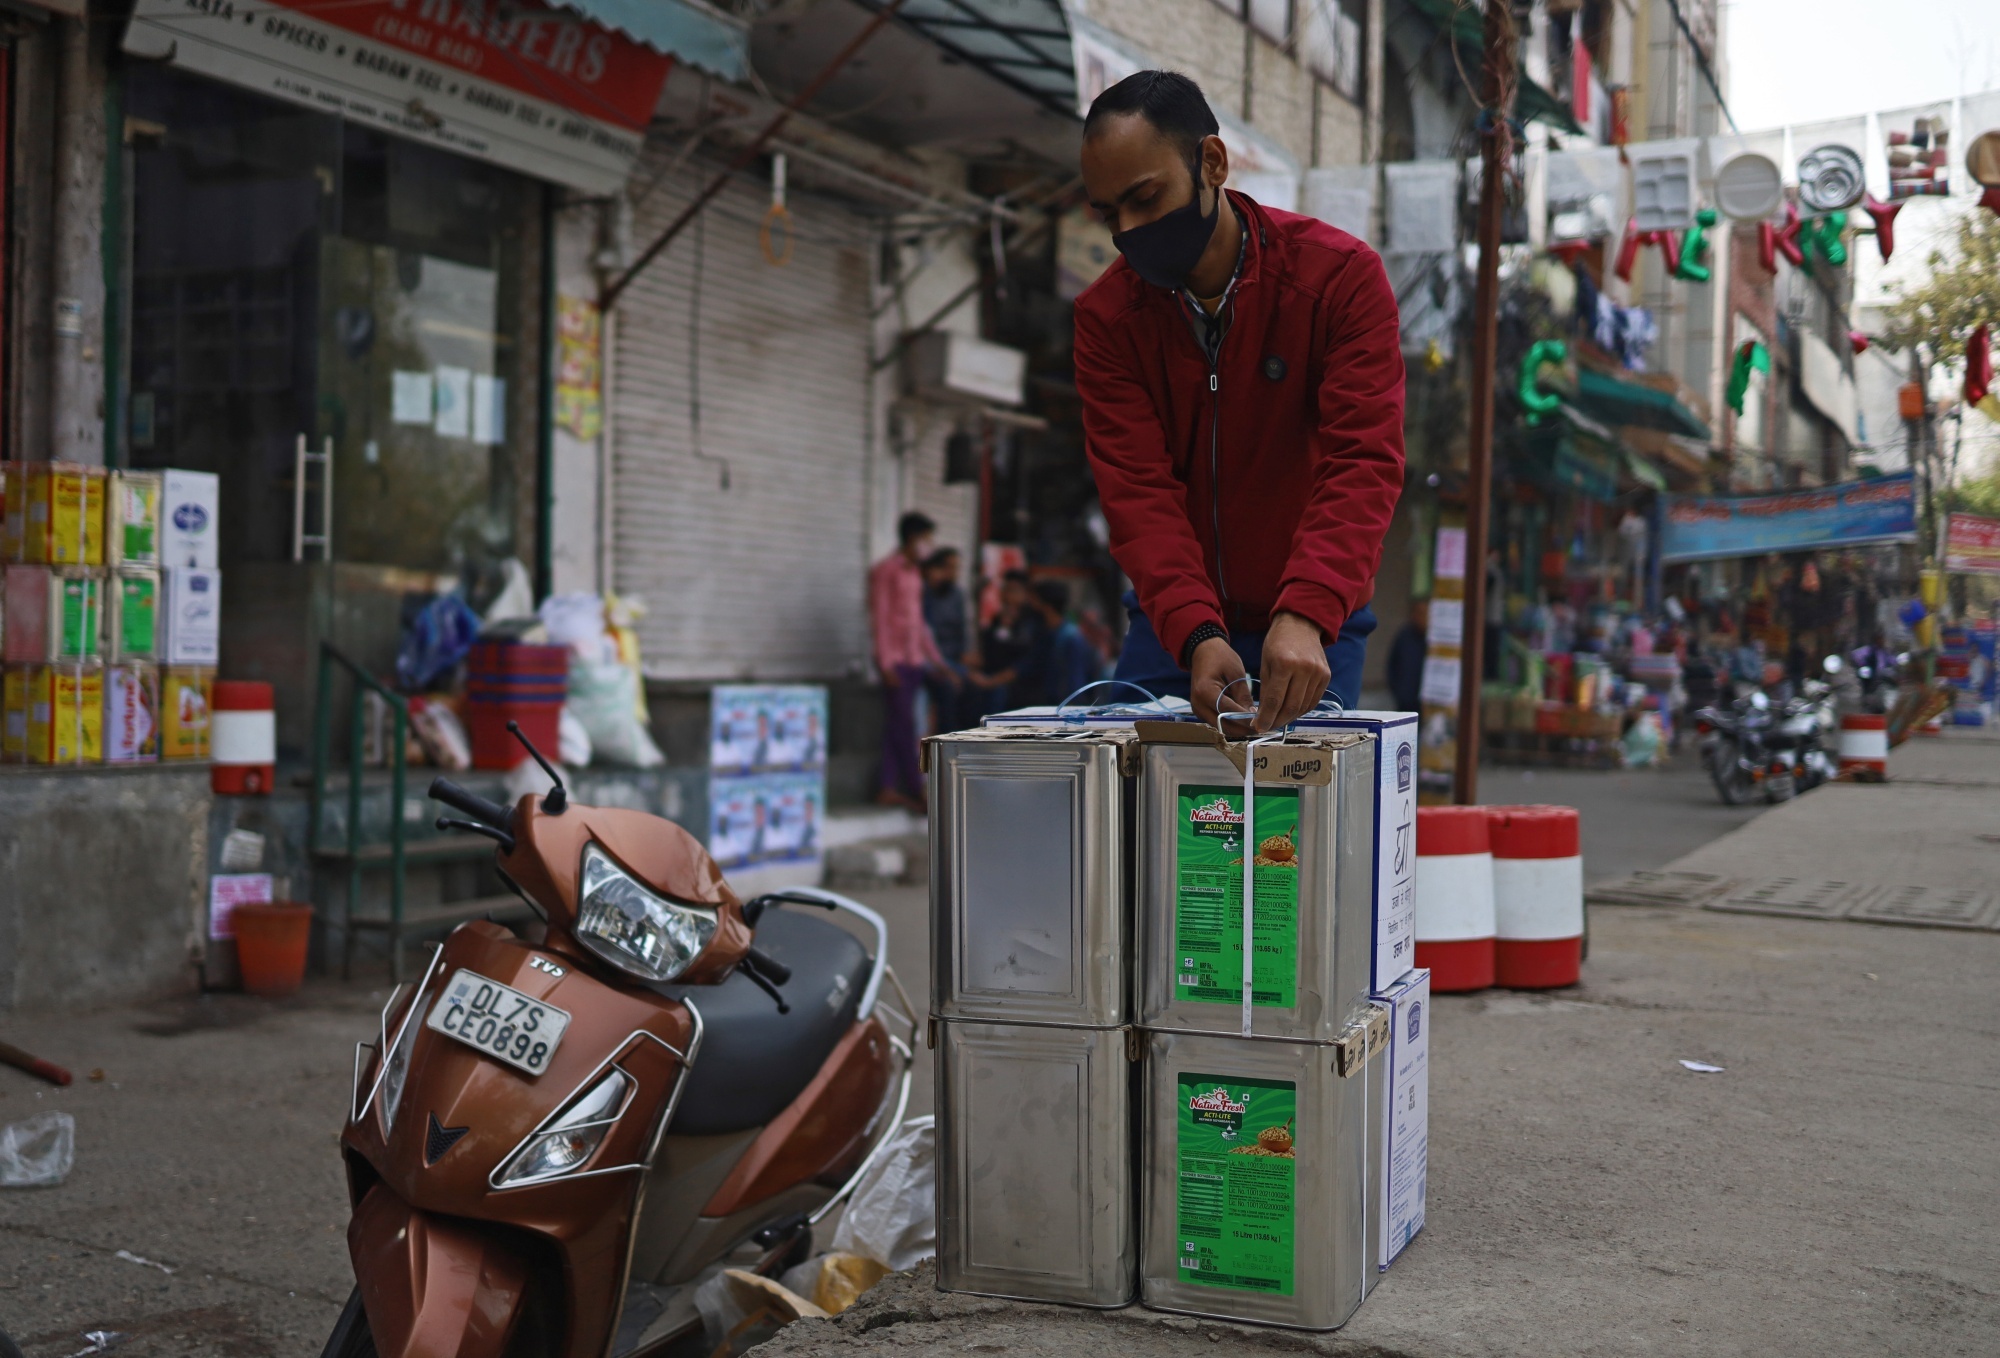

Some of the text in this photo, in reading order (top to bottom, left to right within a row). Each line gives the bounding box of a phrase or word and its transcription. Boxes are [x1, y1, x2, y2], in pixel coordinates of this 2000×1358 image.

[263, 16, 330, 54] SPICES
[1283, 759, 1321, 779] Cargill
[1204, 823, 1233, 831] ACTI-LITE
[1254, 945, 1271, 953] (13.65
[529, 956, 566, 978] TVS
[471, 984, 544, 1032] DL 7S
[443, 1004, 548, 1068] CE0898
[1240, 1231, 1252, 1239] Litre
[1253, 1233, 1270, 1241] (13.65
[1271, 1235, 1277, 1243] kg
